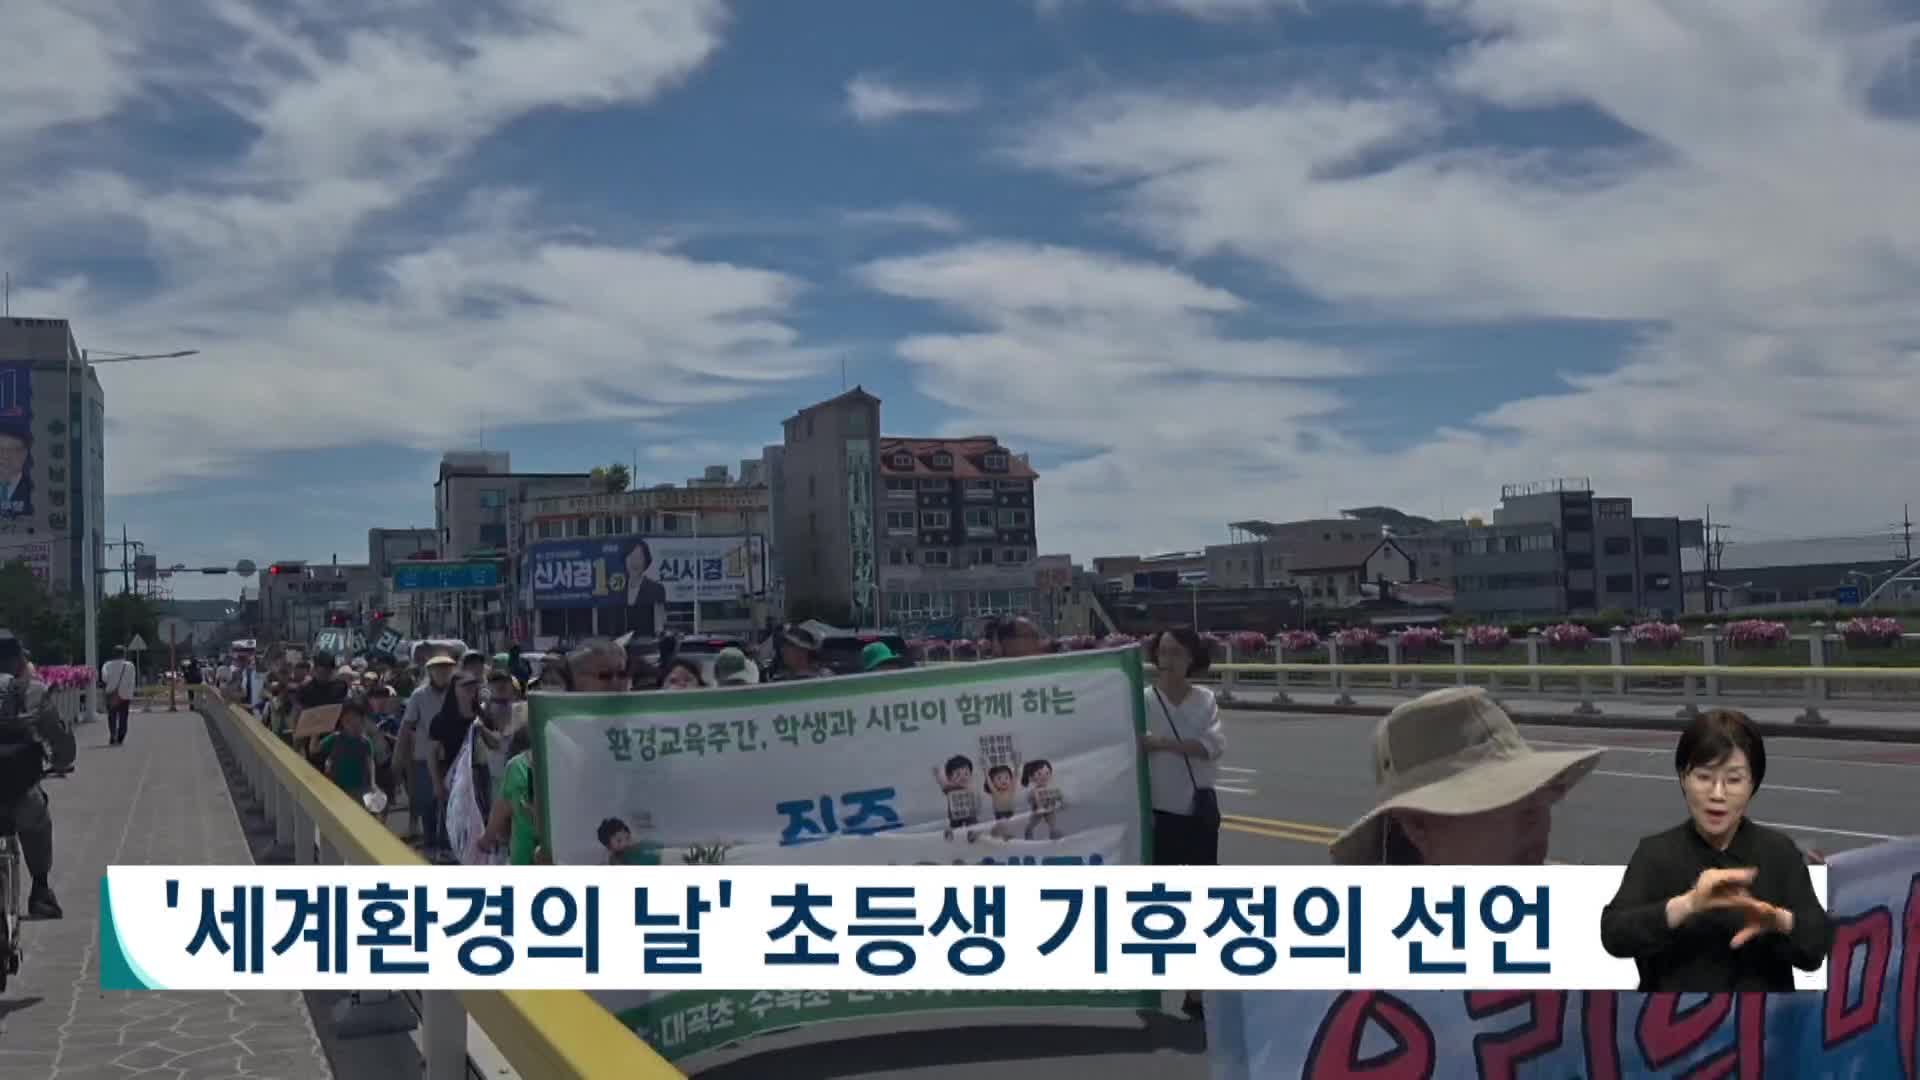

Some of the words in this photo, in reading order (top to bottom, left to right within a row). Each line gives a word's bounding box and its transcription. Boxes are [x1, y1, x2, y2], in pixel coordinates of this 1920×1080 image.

[534, 560, 592, 589] 신서경
[658, 558, 723, 582] 신서경
[606, 719, 768, 762] 환경교육주간,
[772, 706, 856, 747] 학생과
[866, 699, 948, 733] 시민이
[955, 691, 1013, 727] 함께
[1020, 685, 1077, 716] 하는
